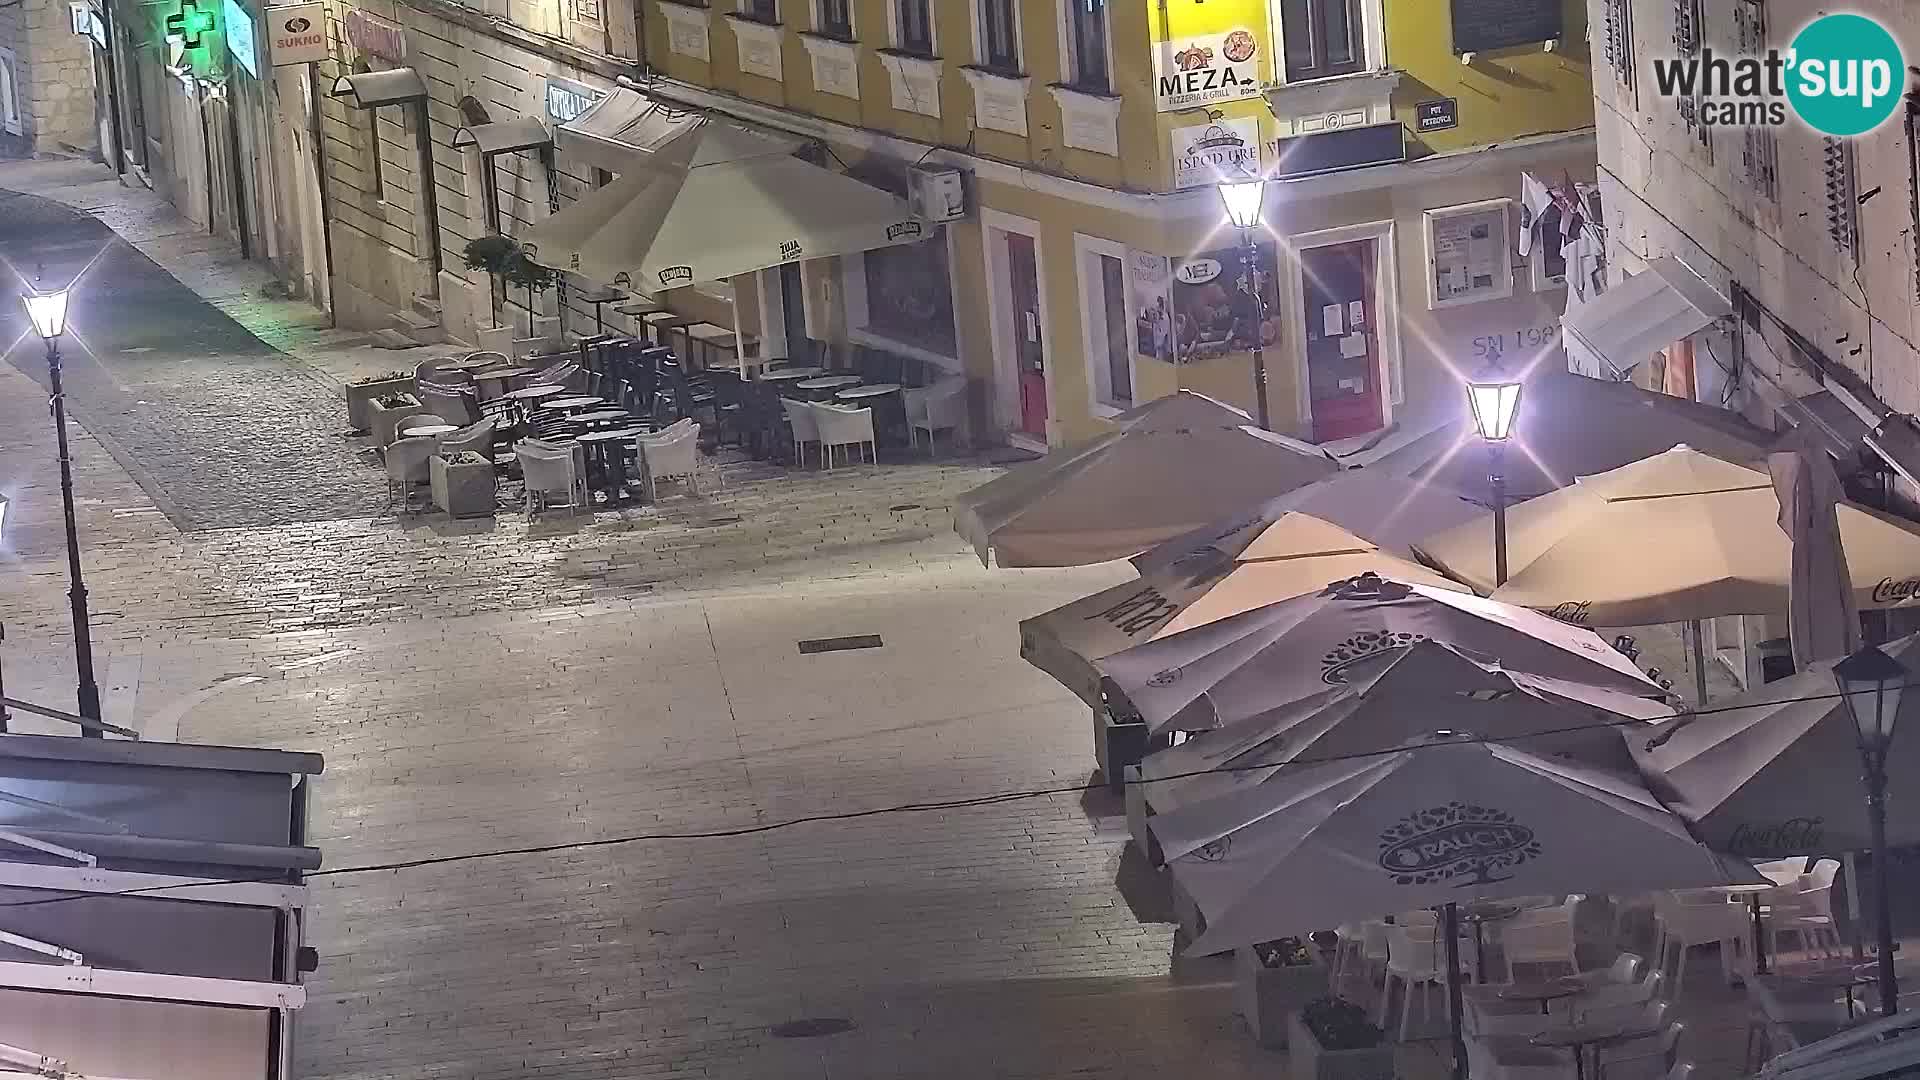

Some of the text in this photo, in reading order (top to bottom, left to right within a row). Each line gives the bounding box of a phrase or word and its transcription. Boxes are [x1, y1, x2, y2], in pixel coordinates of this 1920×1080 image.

[277, 34, 321, 49] SUKNO
[1160, 66, 1238, 97] MEZA
[1169, 92, 1201, 105] PIZZERIA
[1209, 89, 1230, 99] GRILL
[1177, 151, 1223, 171] ISPOD
[1422, 827, 1516, 865] RAUCH
